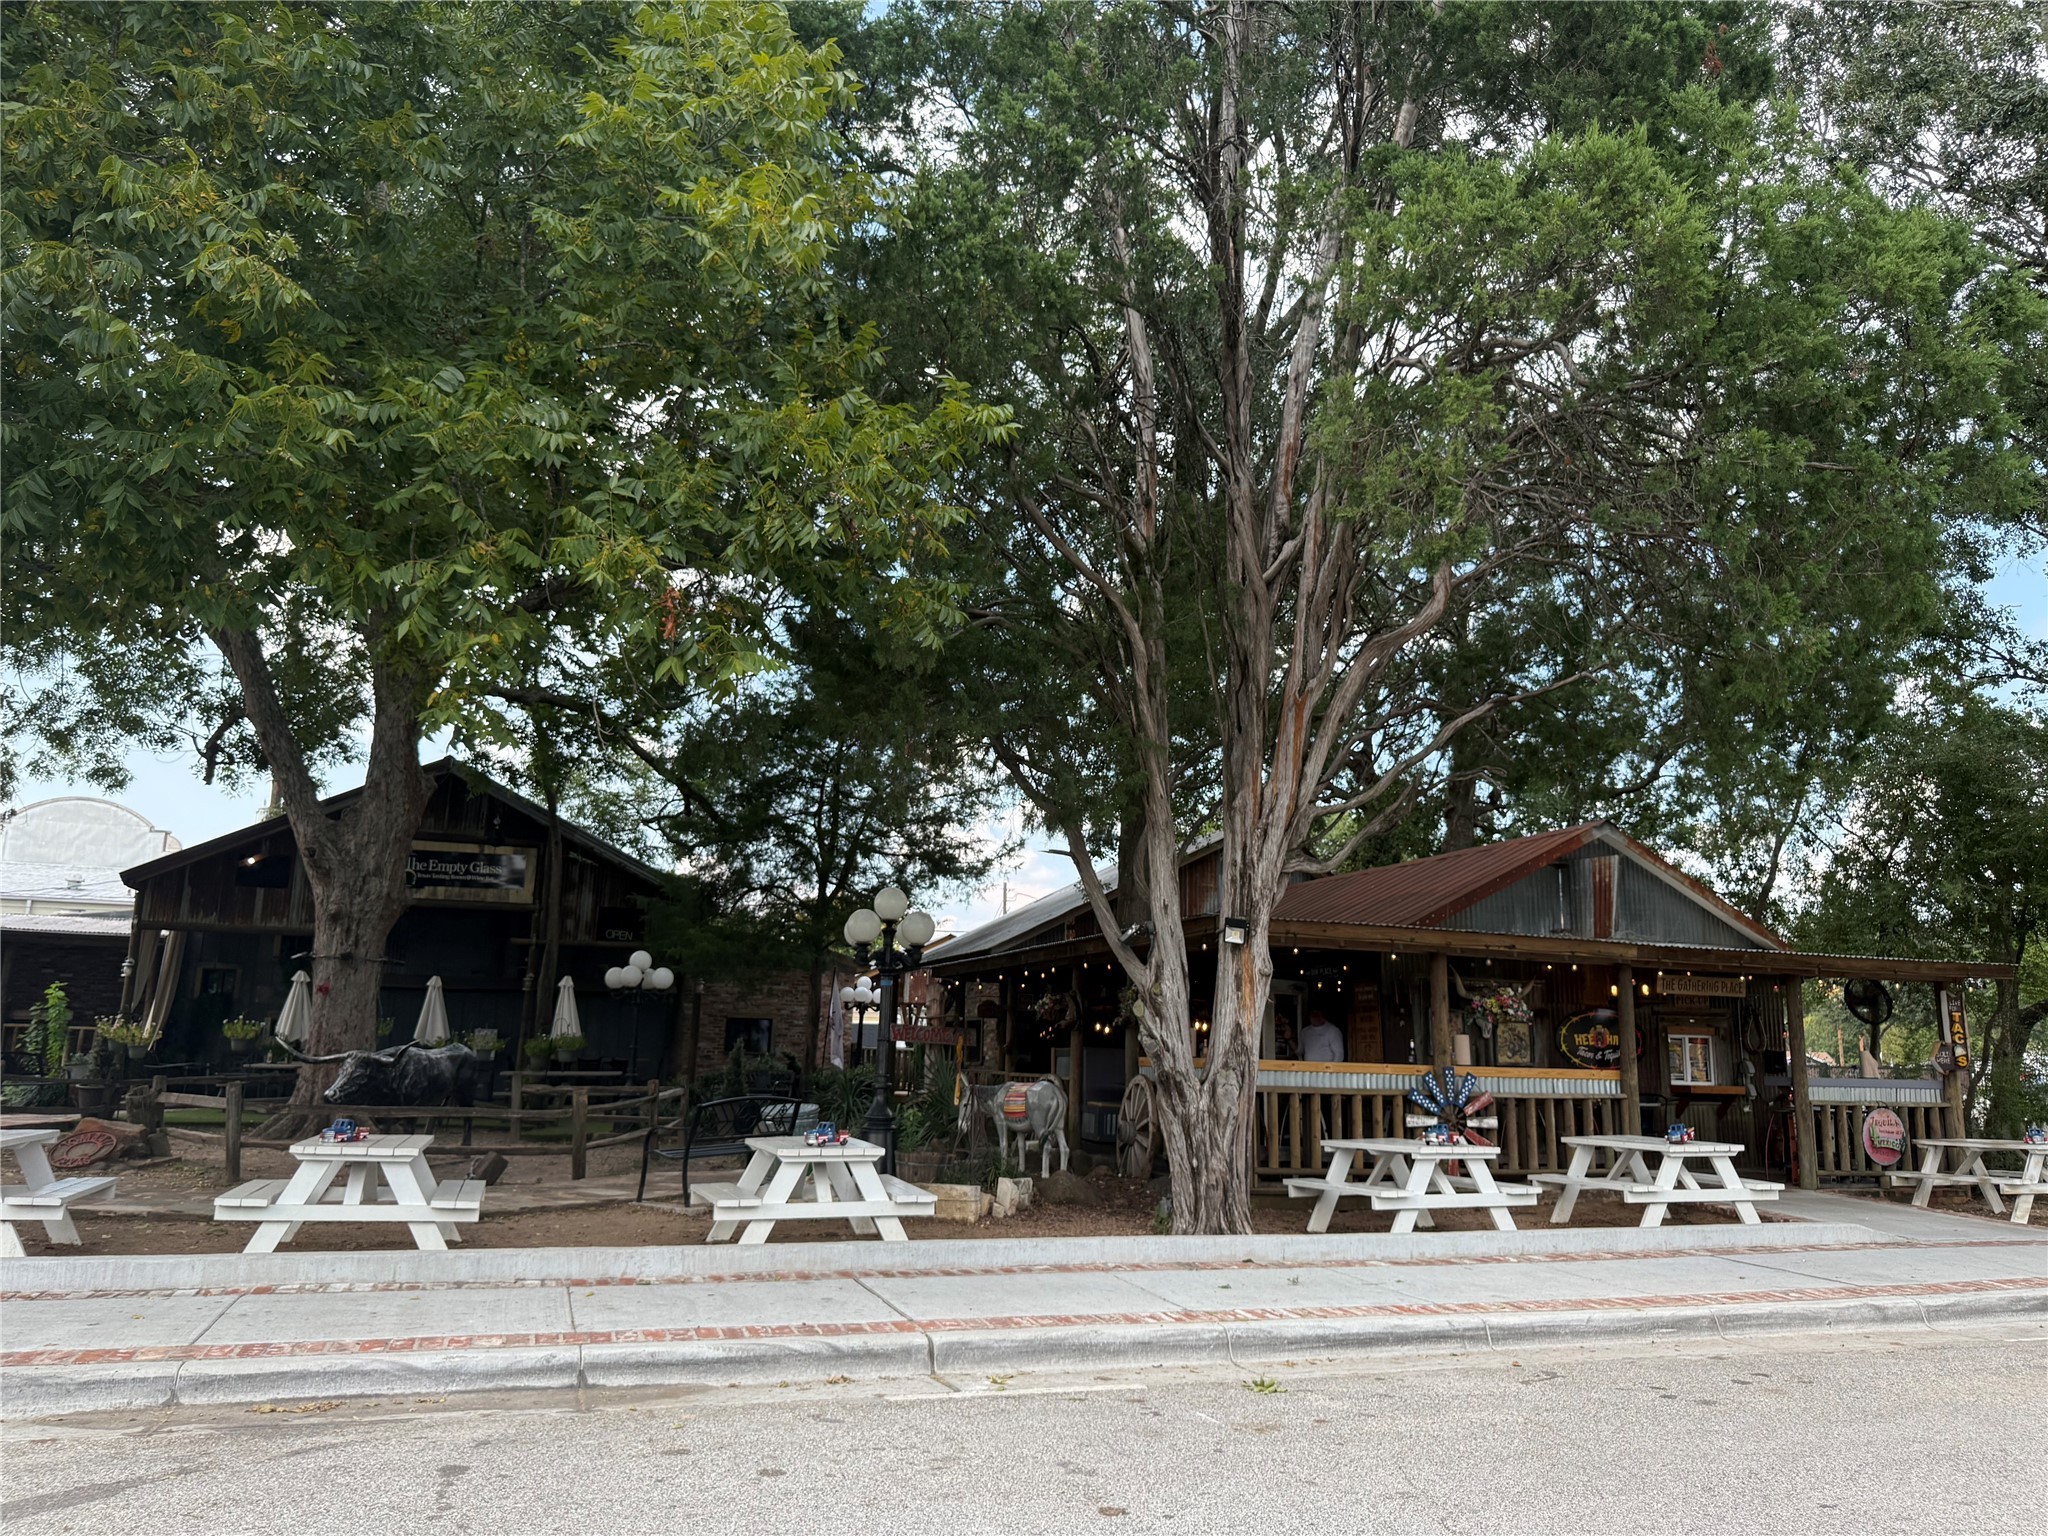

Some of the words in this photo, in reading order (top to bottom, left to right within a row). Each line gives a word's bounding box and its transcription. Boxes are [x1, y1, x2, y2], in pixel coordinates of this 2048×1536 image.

[407, 856, 427, 870] The
[428, 859, 468, 876] Empty
[469, 861, 502, 874] Glass
[605, 929, 633, 941] OPEN
[1662, 979, 1677, 991] THE
[1721, 982, 1744, 995] PLACE
[891, 1024, 952, 1043] WELCOME
[1573, 1033, 1594, 1046] HEE
[1606, 1034, 1619, 1046] HA
[1951, 1011, 1968, 1068] TACS
[1576, 1046, 1594, 1060] Tacos
[1595, 1051, 1603, 1061] &
[1936, 1057, 1951, 1065] HERE
